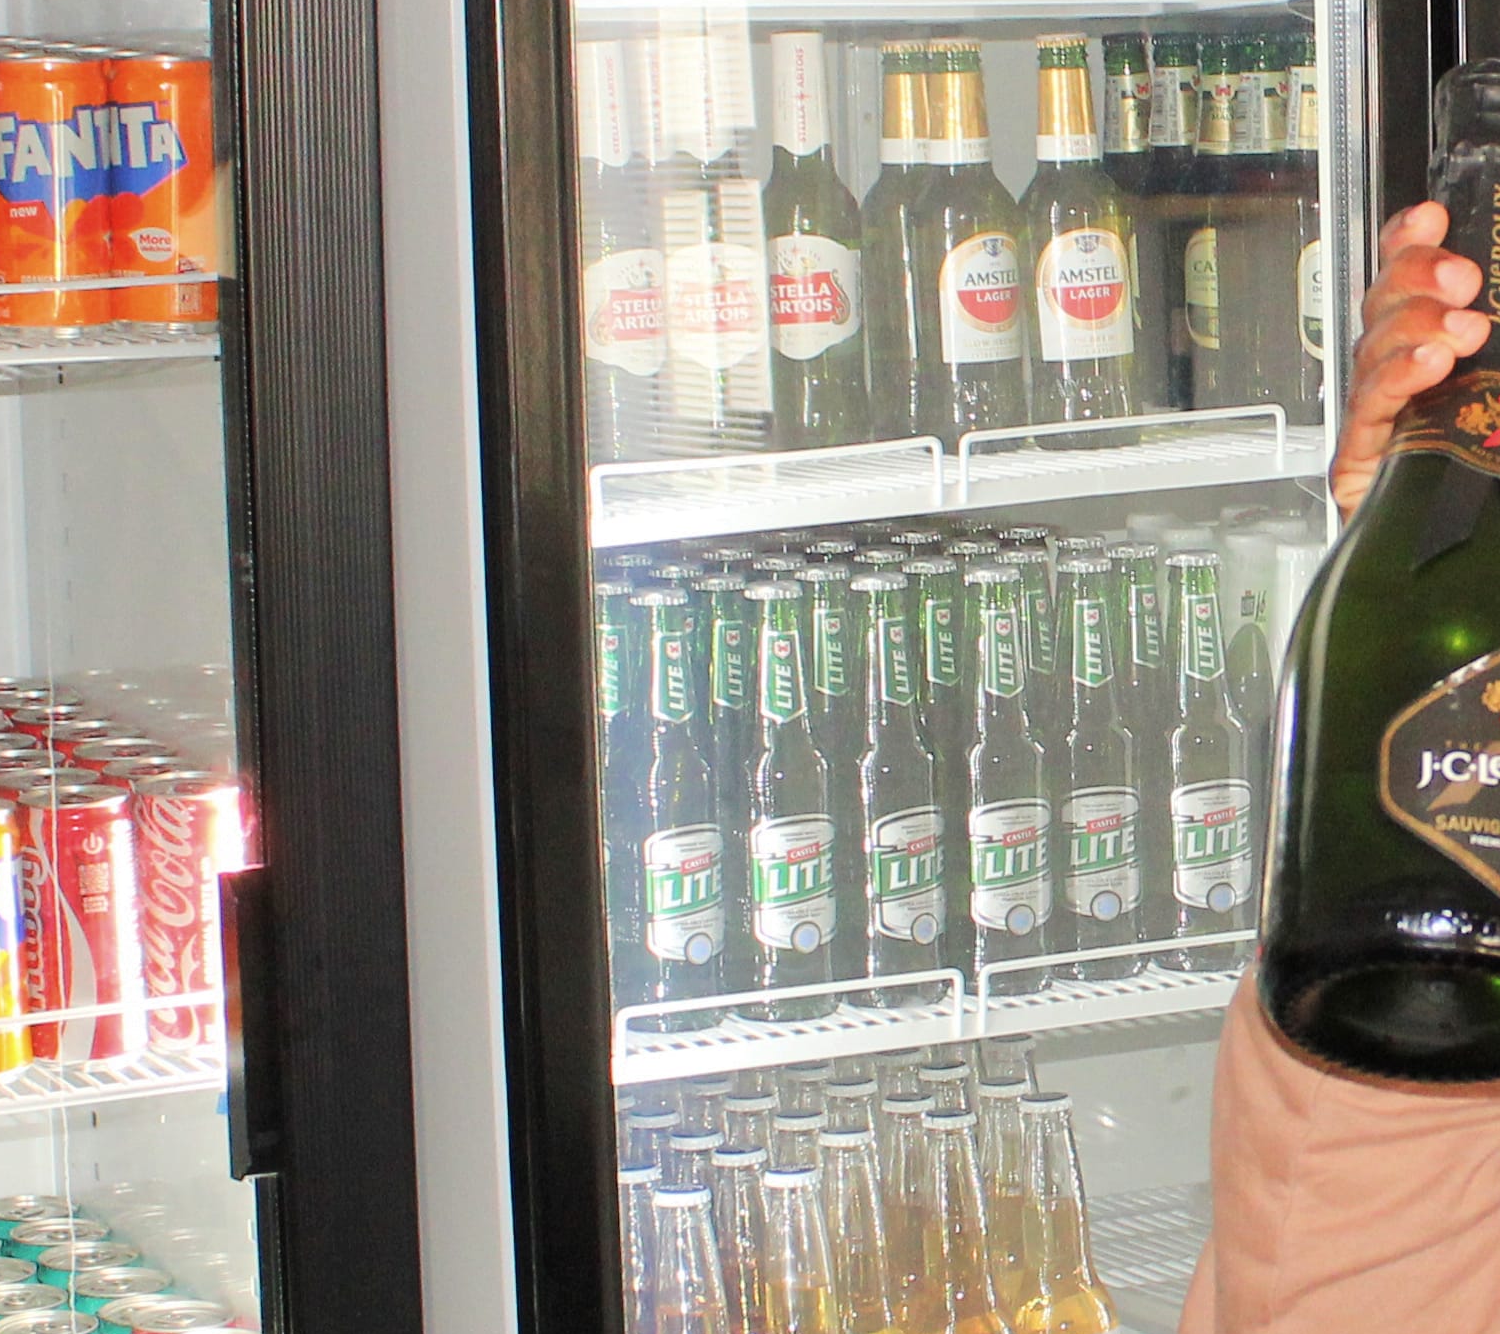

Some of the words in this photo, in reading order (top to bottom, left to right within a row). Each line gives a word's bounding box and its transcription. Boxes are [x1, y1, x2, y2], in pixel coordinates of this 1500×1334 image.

[9, 203, 38, 219] new
[139, 233, 172, 247] More
[1058, 266, 1119, 284] AMSTEL
[1069, 285, 1111, 300] LAGER
[976, 290, 1012, 304] LAGER
[999, 642, 1015, 686] LITE
[1086, 631, 1102, 676] LITE
[1199, 625, 1214, 669] LITE
[667, 665, 685, 711] LITE
[774, 662, 793, 709] LITE
[1006, 828, 1035, 844] CASTLE
[1089, 817, 1118, 831] CASTLE
[1206, 808, 1234, 823] CASTLE
[789, 844, 819, 861] CASTLE
[985, 835, 1047, 881] LITE
[1070, 824, 1135, 866] LITE
[1186, 819, 1248, 860] LITE
[660, 865, 721, 909] LITE
[768, 852, 833, 897] LITE
[889, 847, 943, 890] LITE
